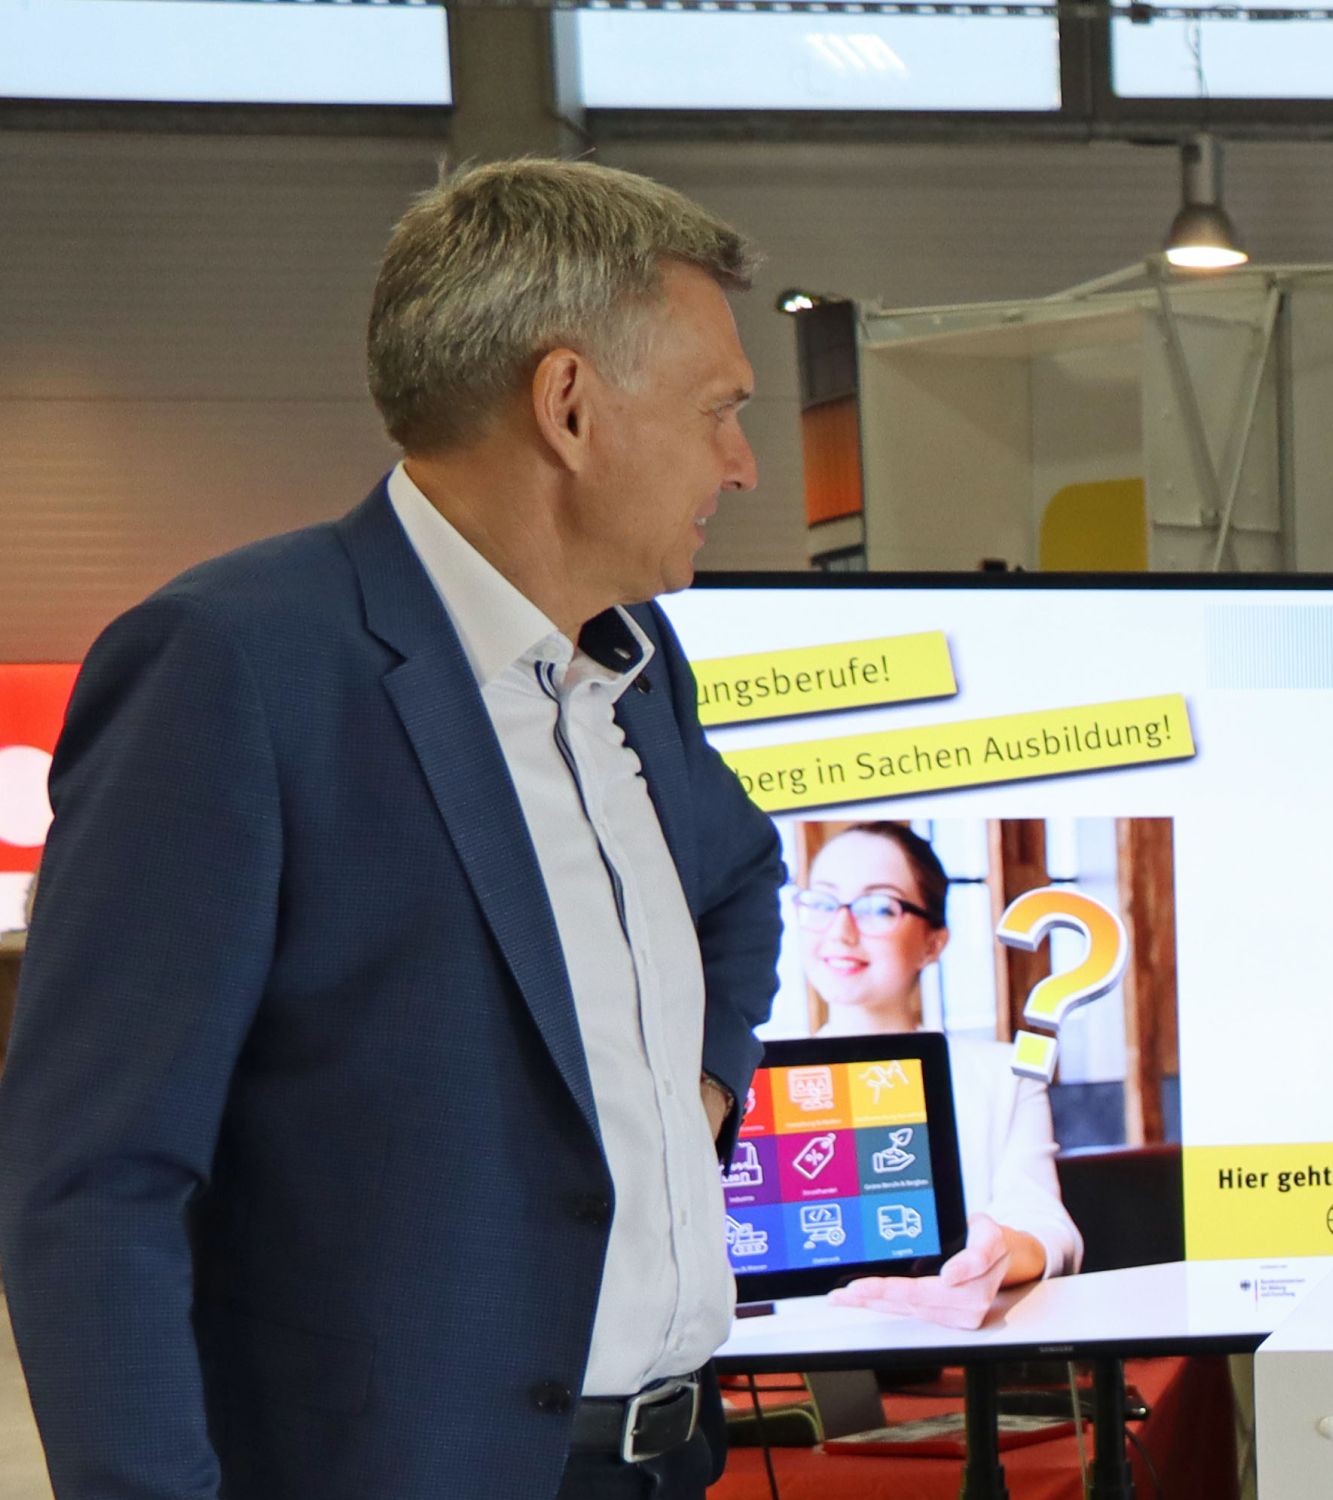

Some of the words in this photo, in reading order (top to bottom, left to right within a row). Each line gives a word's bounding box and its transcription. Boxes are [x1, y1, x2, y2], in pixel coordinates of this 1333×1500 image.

[816, 757, 845, 785] in
[856, 745, 972, 781] Sachen
[984, 714, 1172, 766] Ausbildung!
[1218, 1167, 1268, 1190] Hier
